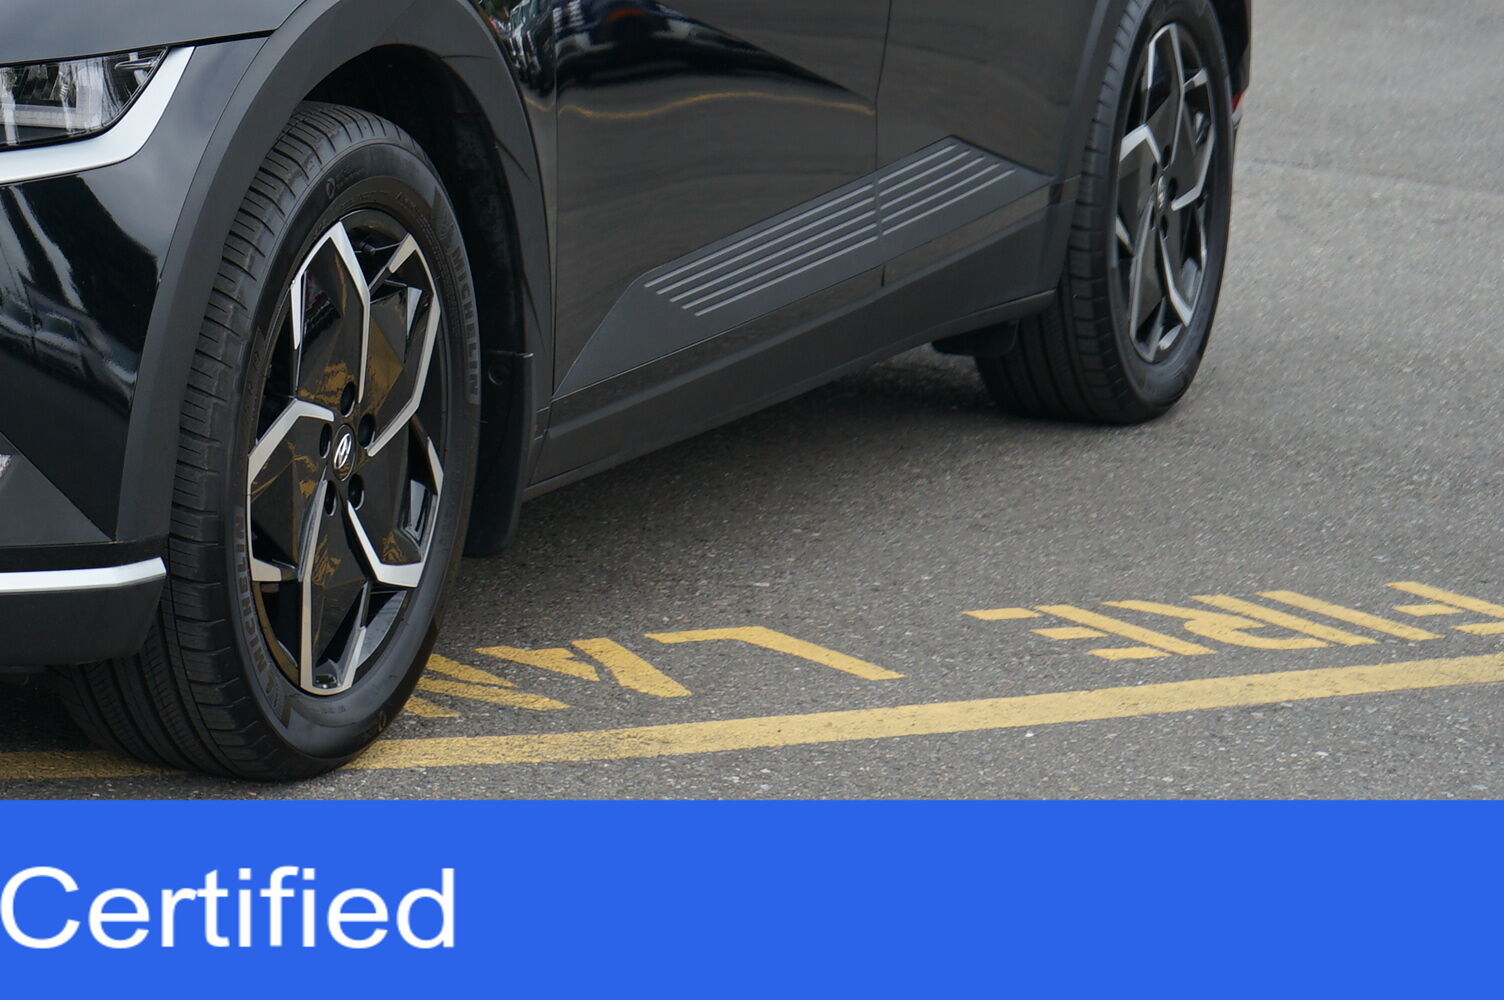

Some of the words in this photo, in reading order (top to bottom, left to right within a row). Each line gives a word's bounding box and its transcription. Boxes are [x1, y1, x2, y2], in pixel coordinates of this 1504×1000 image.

[450, 248, 481, 396] MICHELIN
[234, 513, 269, 673] MICHELIN
[401, 625, 907, 718] LAN
